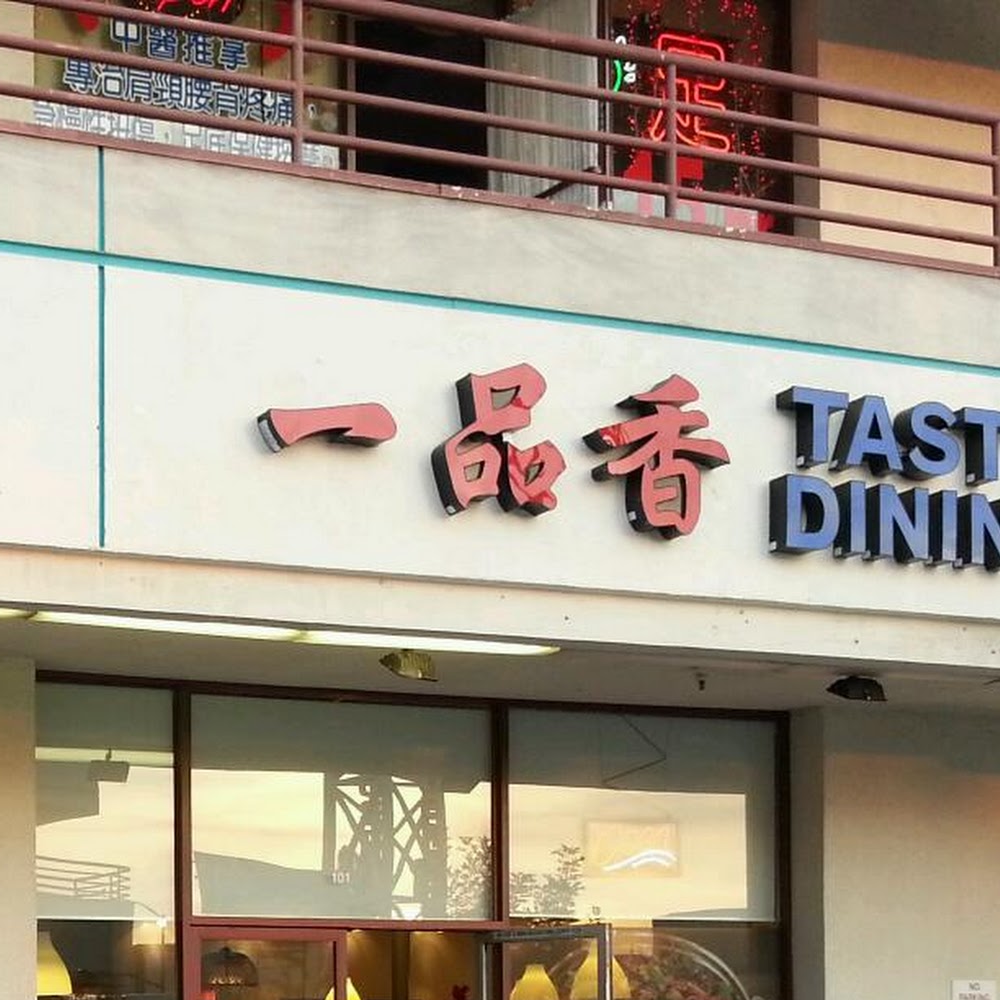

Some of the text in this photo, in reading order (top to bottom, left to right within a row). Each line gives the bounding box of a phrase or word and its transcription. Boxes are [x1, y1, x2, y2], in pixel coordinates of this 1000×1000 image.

[257, 363, 729, 539] 一品香
[331, 871, 351, 885] 101
